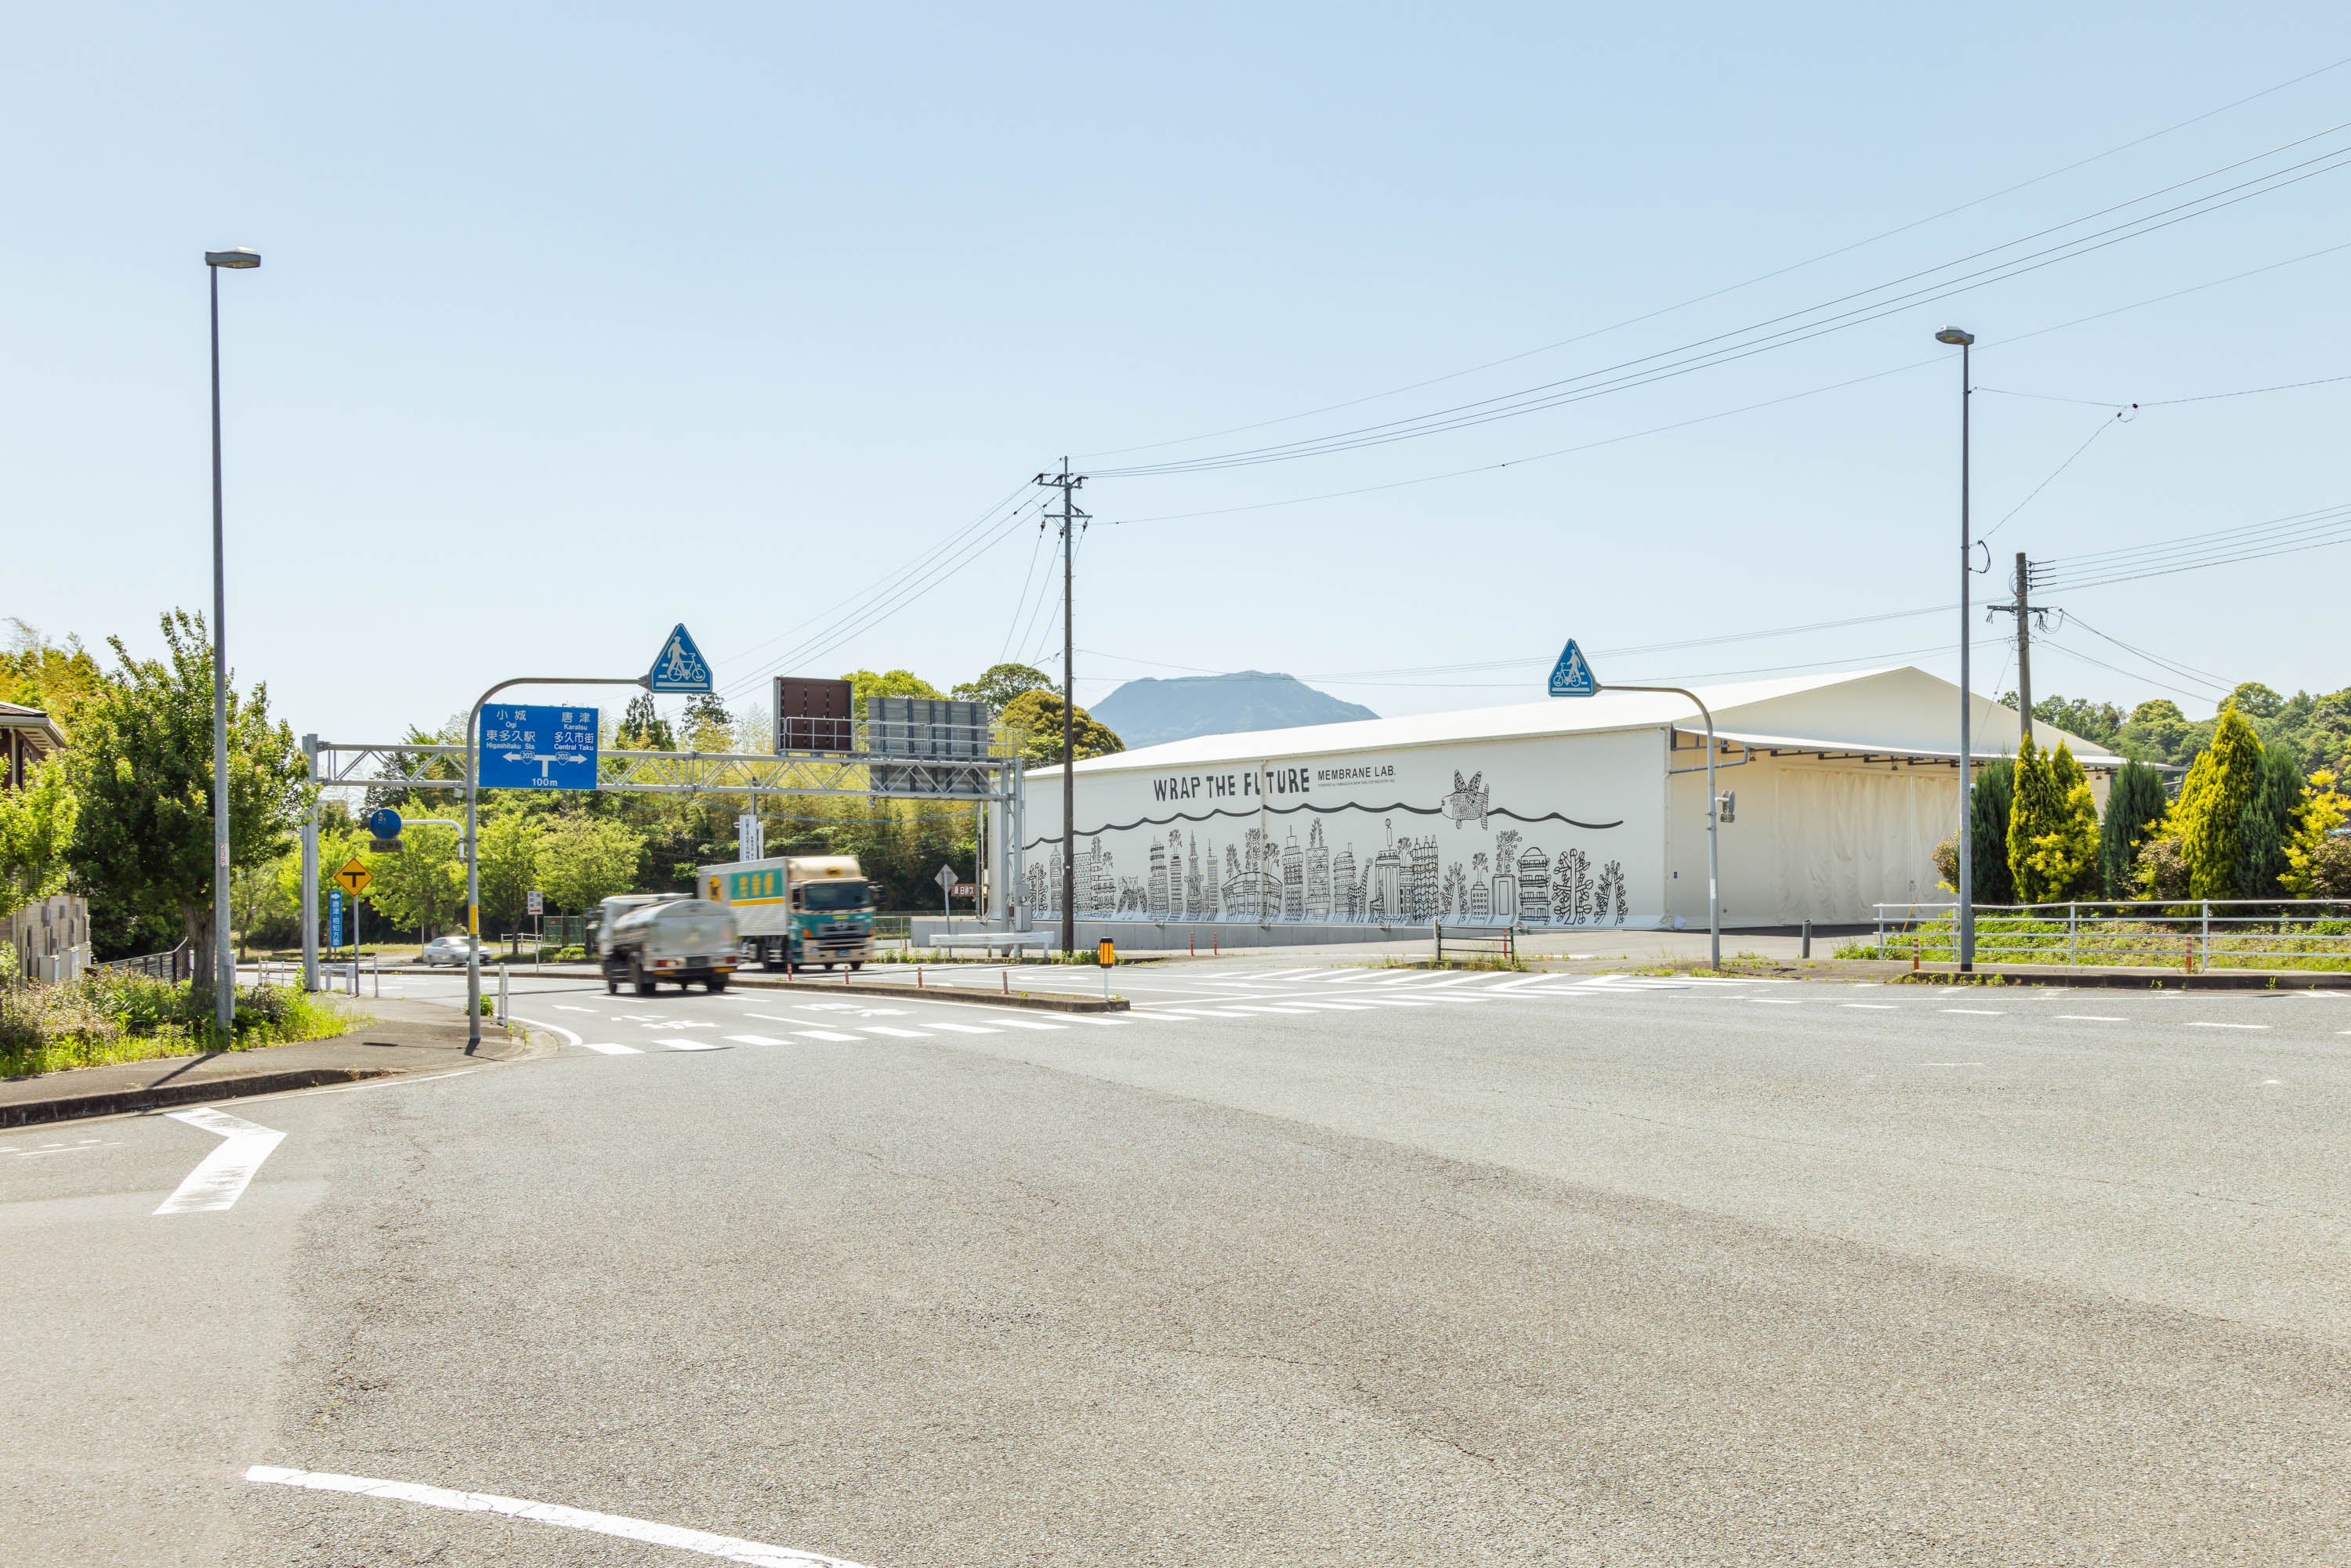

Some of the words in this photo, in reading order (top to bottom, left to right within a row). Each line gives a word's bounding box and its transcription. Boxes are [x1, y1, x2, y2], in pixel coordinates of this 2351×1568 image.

[496, 708, 527, 722] 小城
[562, 712, 590, 723] 唐津
[505, 721, 517, 730] Ogi
[486, 730, 536, 742] 東多久駅
[553, 731, 595, 744] 多久市街
[1317, 767, 1371, 780] MEMBRANE
[1375, 766, 1396, 777] LAB.
[532, 778, 558, 787] 100m
[1154, 777, 1201, 802] WRAP
[1206, 775, 1236, 798] THE
